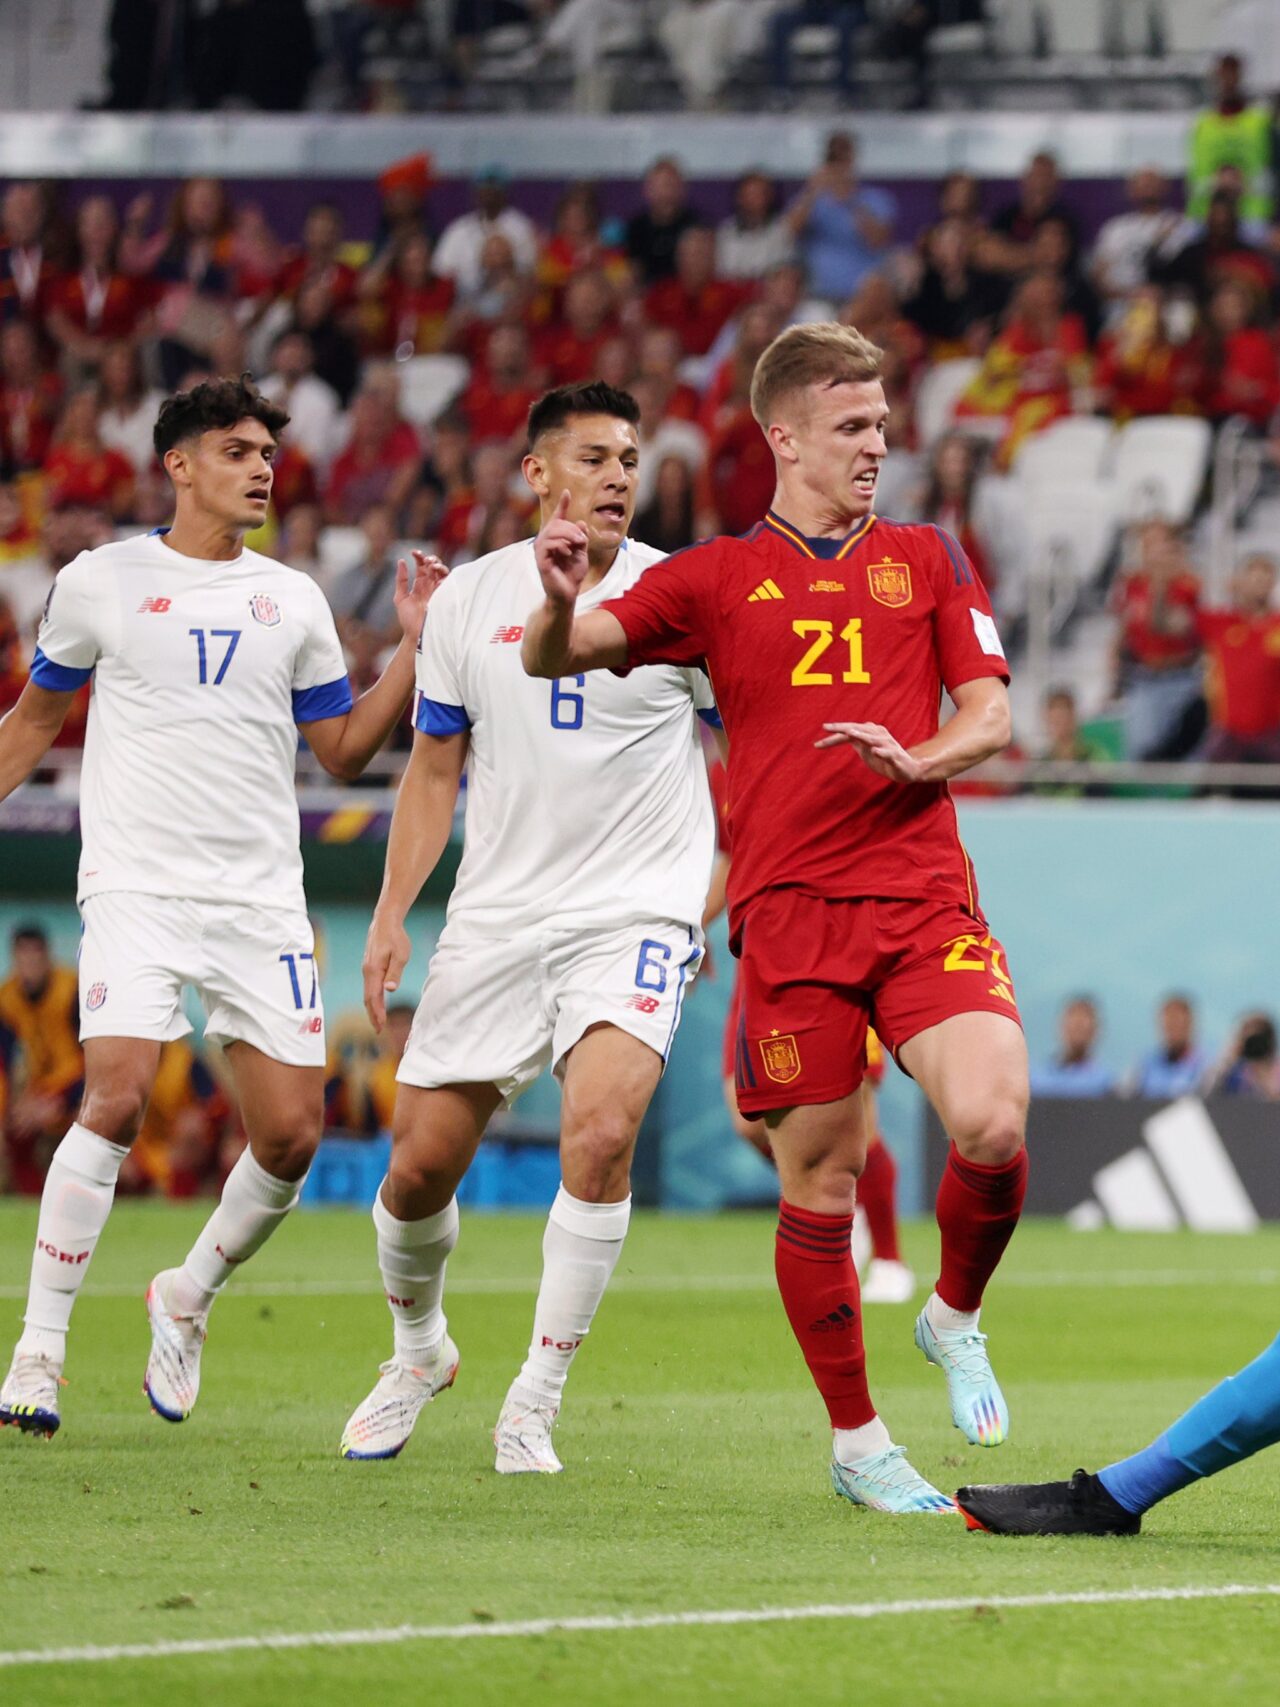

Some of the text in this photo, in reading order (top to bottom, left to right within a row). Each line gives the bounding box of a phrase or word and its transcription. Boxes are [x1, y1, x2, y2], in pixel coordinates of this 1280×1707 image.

[188, 628, 243, 686] 17
[790, 617, 872, 687] 21
[550, 672, 586, 731] 6
[634, 938, 672, 994] 6
